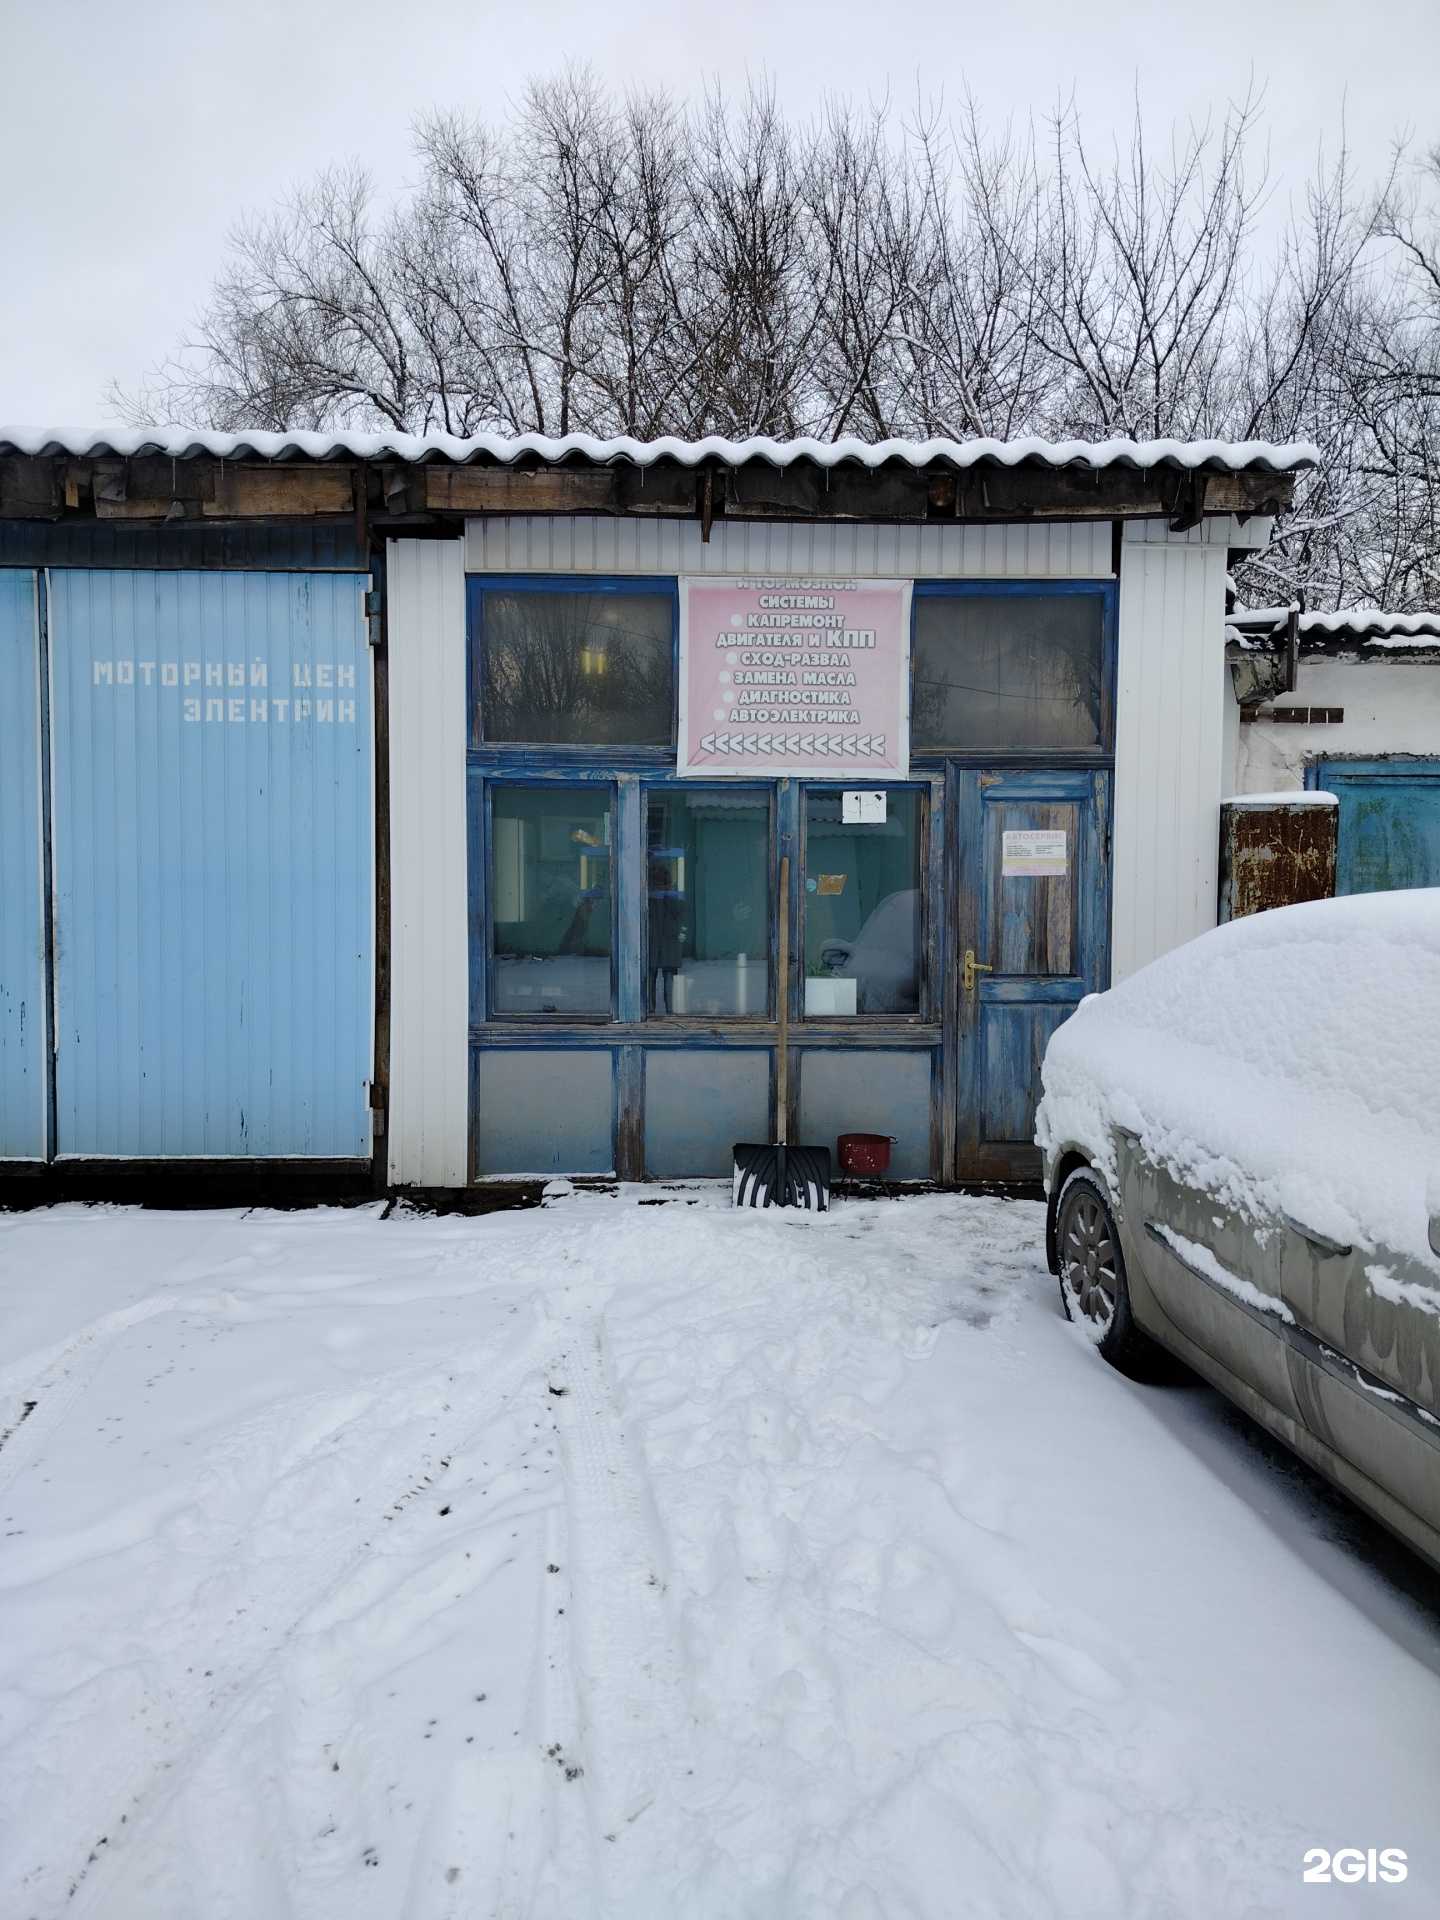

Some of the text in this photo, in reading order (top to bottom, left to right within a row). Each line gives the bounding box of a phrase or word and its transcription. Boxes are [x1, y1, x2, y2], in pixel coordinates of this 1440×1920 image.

[759, 595, 834, 609] СИСТЕМЫ
[747, 614, 845, 629] КАПРЕМОНТ
[715, 632, 803, 648] ДВИГАТЕЛЯ
[826, 629, 876, 648] КПП
[740, 652, 850, 668] СХОД-РАЗВАЛ
[93, 657, 268, 687] МОТОРНЫЙ
[733, 671, 856, 686] ЗАМЕНА МАСЛА
[738, 690, 851, 706] ДИАГНОСТИКА
[729, 708, 860, 724] АВТОЭЛЕКТРИКА
